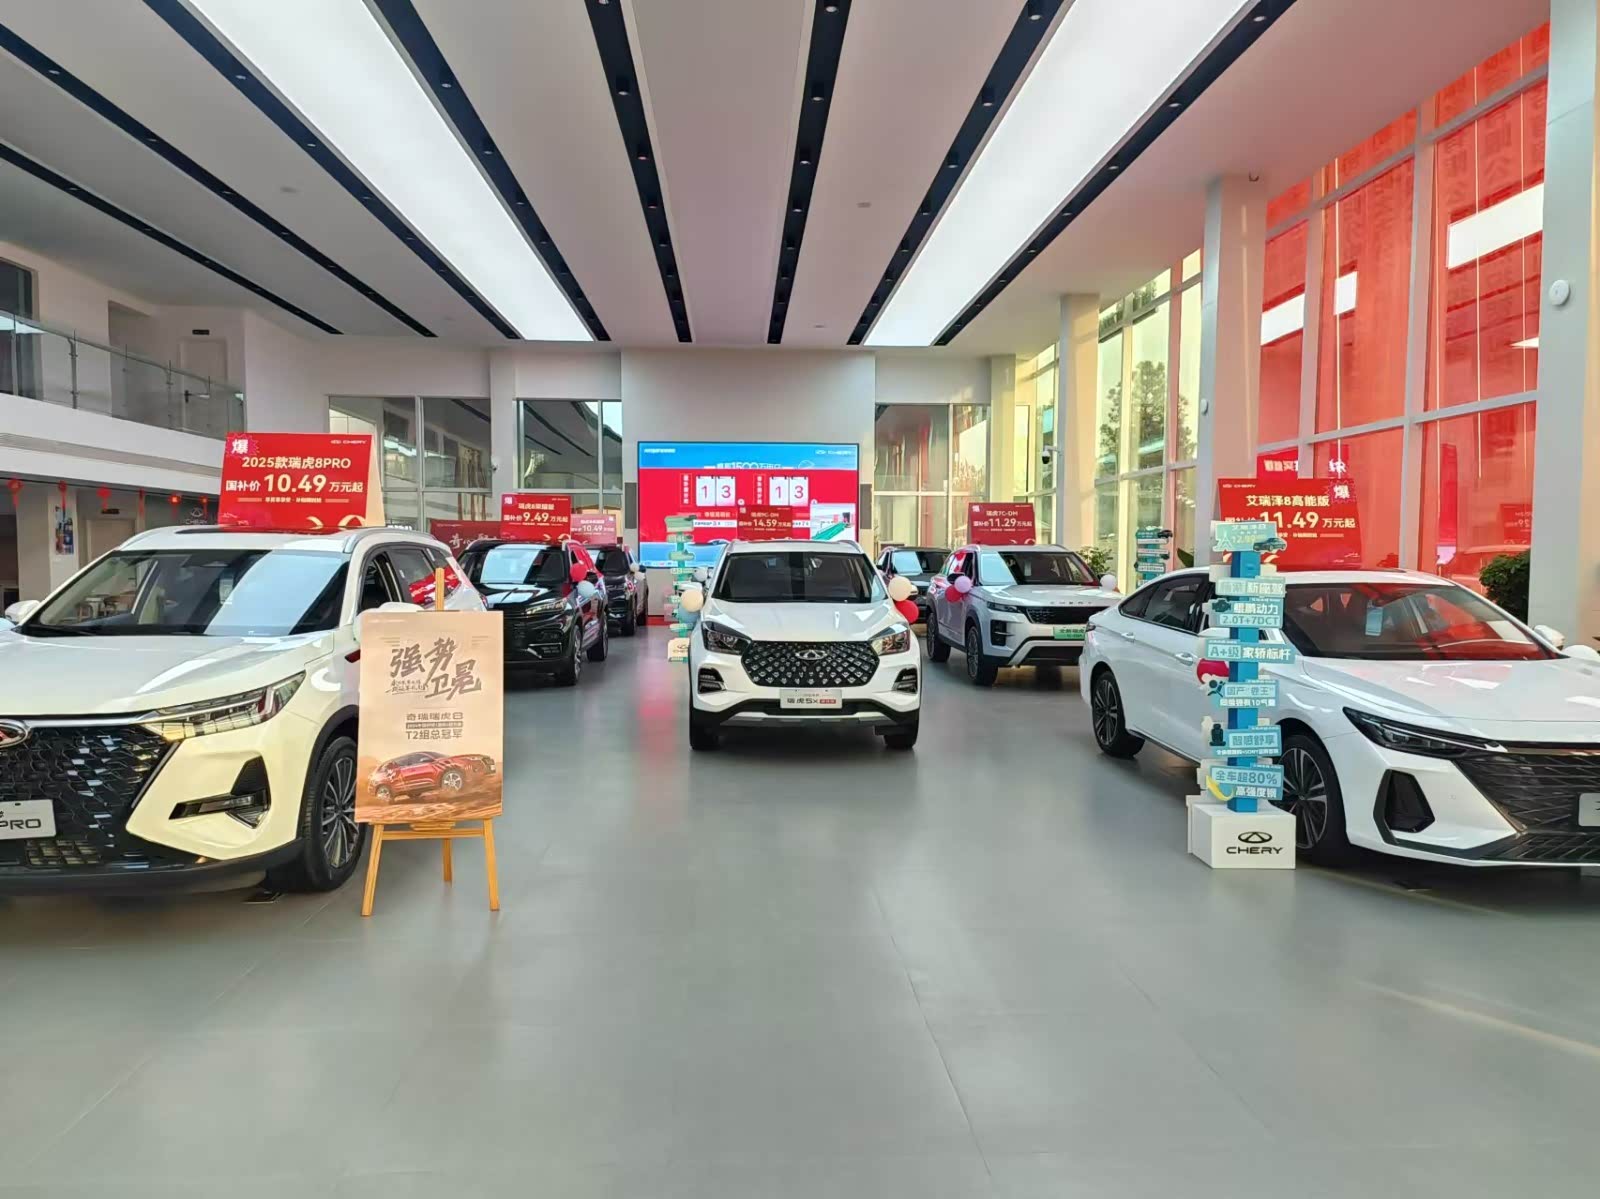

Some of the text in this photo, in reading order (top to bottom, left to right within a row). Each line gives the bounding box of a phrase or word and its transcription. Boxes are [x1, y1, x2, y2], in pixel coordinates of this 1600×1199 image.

[231, 439, 248, 454] 爆
[242, 456, 351, 469] 2025款瑞虎8PRO
[225, 474, 363, 493] 国补价 10.49 万元起
[1246, 495, 1330, 507] 艾瑞泽8高能版
[523, 512, 549, 522] 9.49
[1259, 511, 1319, 529] 11.49
[1322, 518, 1356, 528] 万元起
[753, 519, 777, 527] 14.59
[989, 519, 1016, 527] 11.29
[1222, 615, 1280, 625] 2.0T+7DCT
[406, 712, 463, 721] 奇瑞瑞虎8
[406, 729, 462, 739] T2组总冠军
[1215, 769, 1278, 785] 全车超80%
[1226, 846, 1283, 854] CHERY
